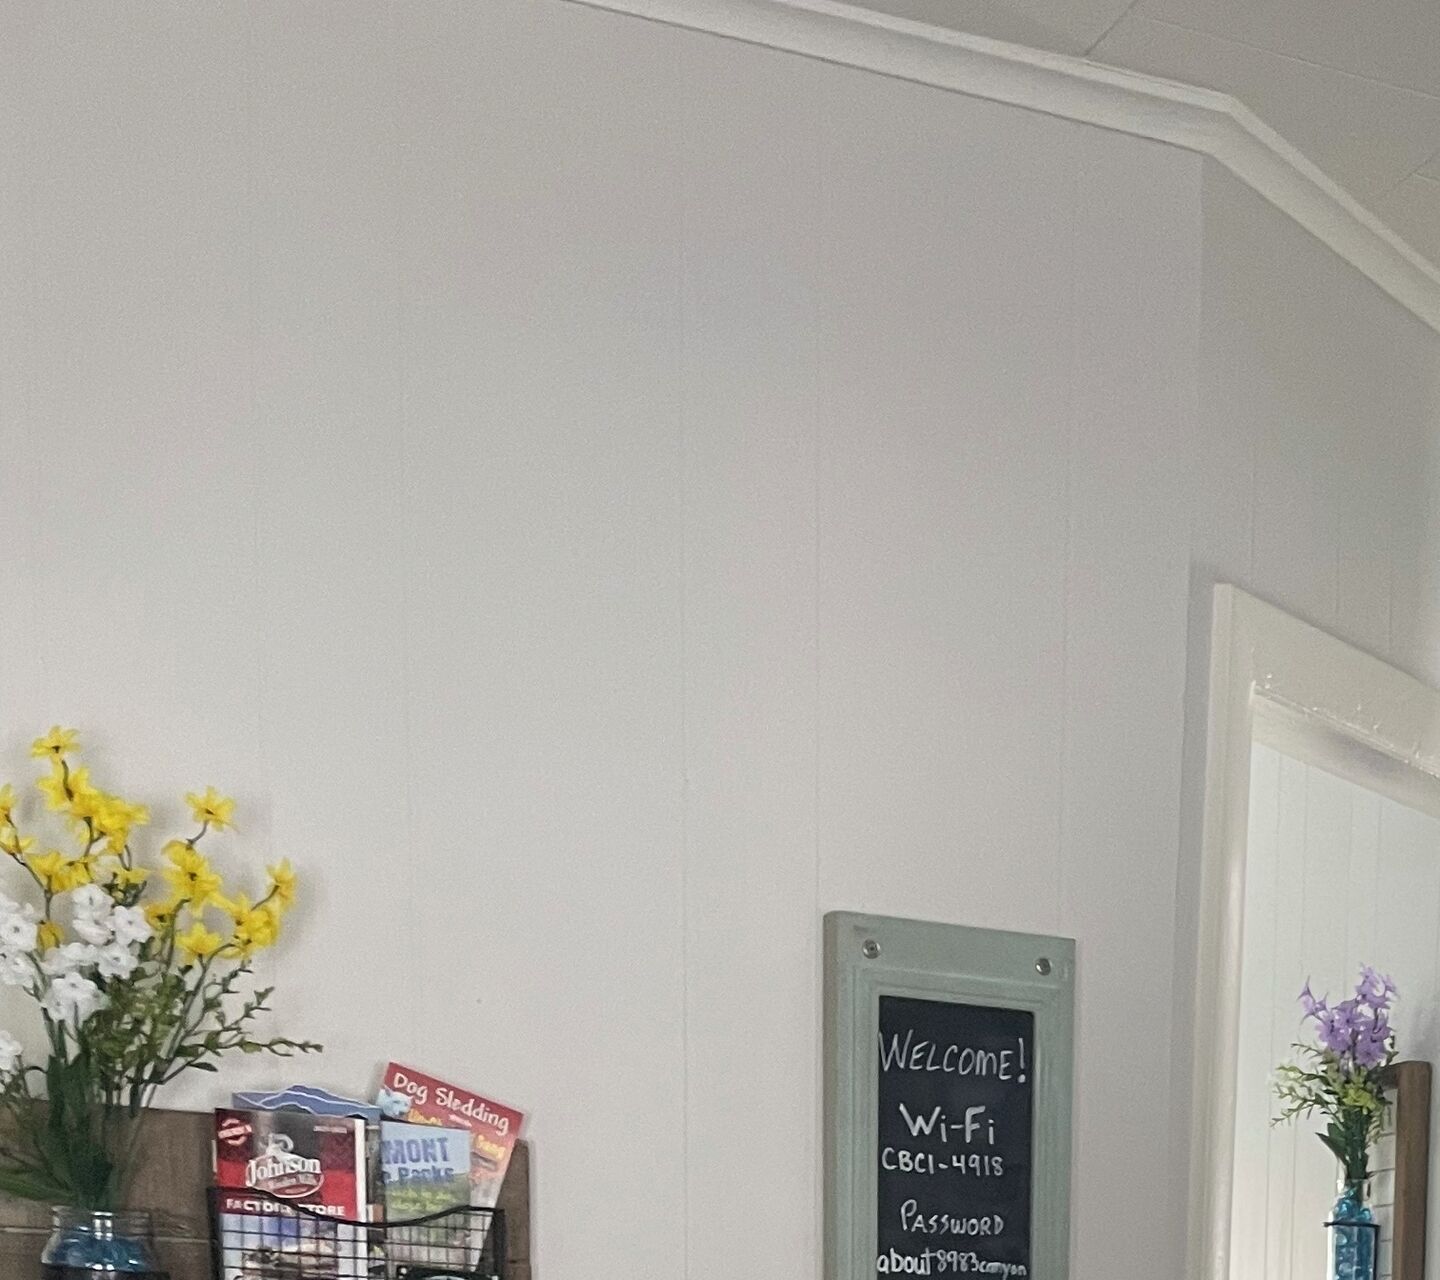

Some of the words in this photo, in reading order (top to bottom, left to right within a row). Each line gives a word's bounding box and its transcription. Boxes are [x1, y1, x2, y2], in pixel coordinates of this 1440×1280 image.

[879, 1029, 1026, 1083] WELCOME!
[394, 1073, 428, 1105] Dog
[435, 1087, 509, 1136] Sledding
[899, 1103, 994, 1145] Wi-Fi
